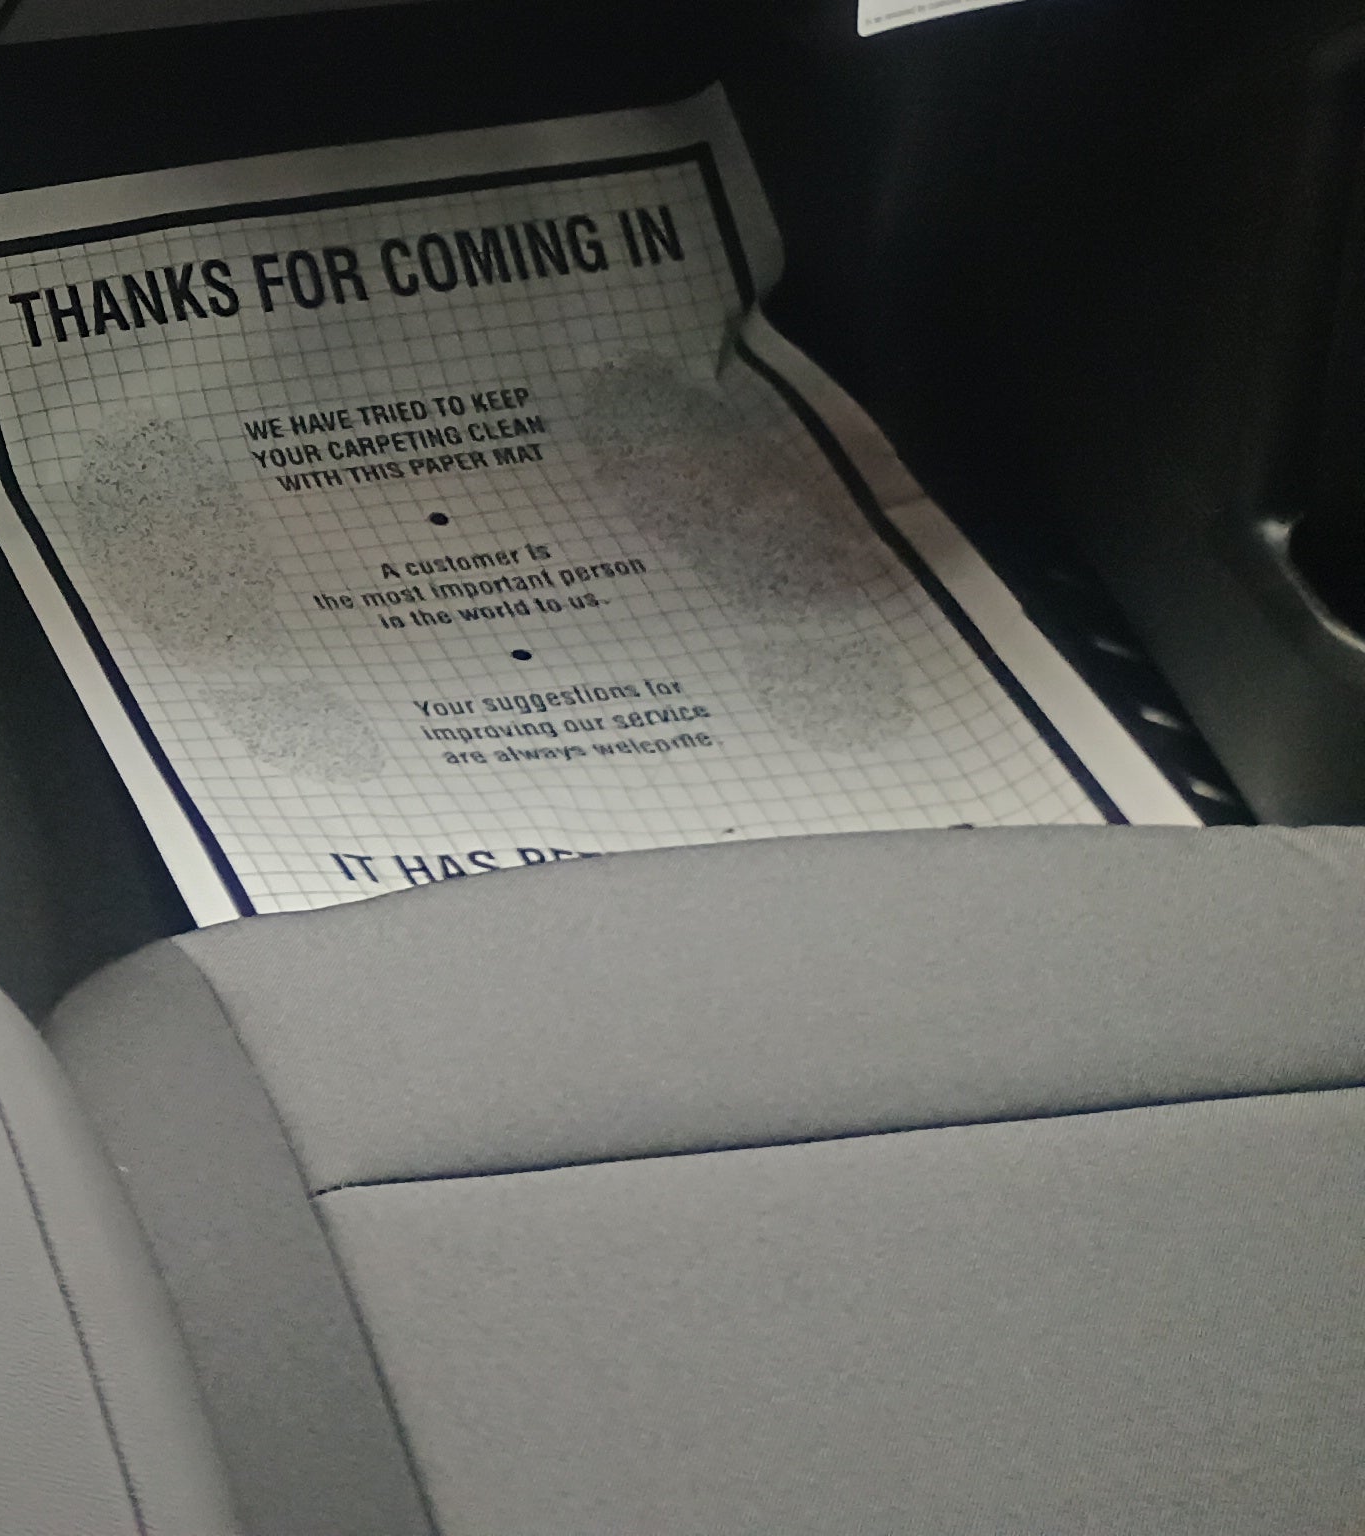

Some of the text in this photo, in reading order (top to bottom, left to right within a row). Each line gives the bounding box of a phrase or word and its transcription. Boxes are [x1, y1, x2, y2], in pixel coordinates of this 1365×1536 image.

[7, 203, 686, 349] THANKS FOR COMING IN
[244, 386, 531, 444] WE HAVE TRIED TO KEEP
[252, 414, 547, 471] YOUR CARPETING CLEAN
[275, 442, 545, 493] WITH THIS PAPER MAT
[313, 554, 648, 612] the most important person
[379, 542, 552, 580] A customer is
[377, 590, 611, 630] in the world to us.
[413, 677, 684, 719] Your suggestions for
[420, 702, 712, 746] improving our service
[443, 747, 488, 765] are
[495, 741, 587, 765] always
[328, 851, 375, 884] IT
[395, 849, 500, 886] HAS
